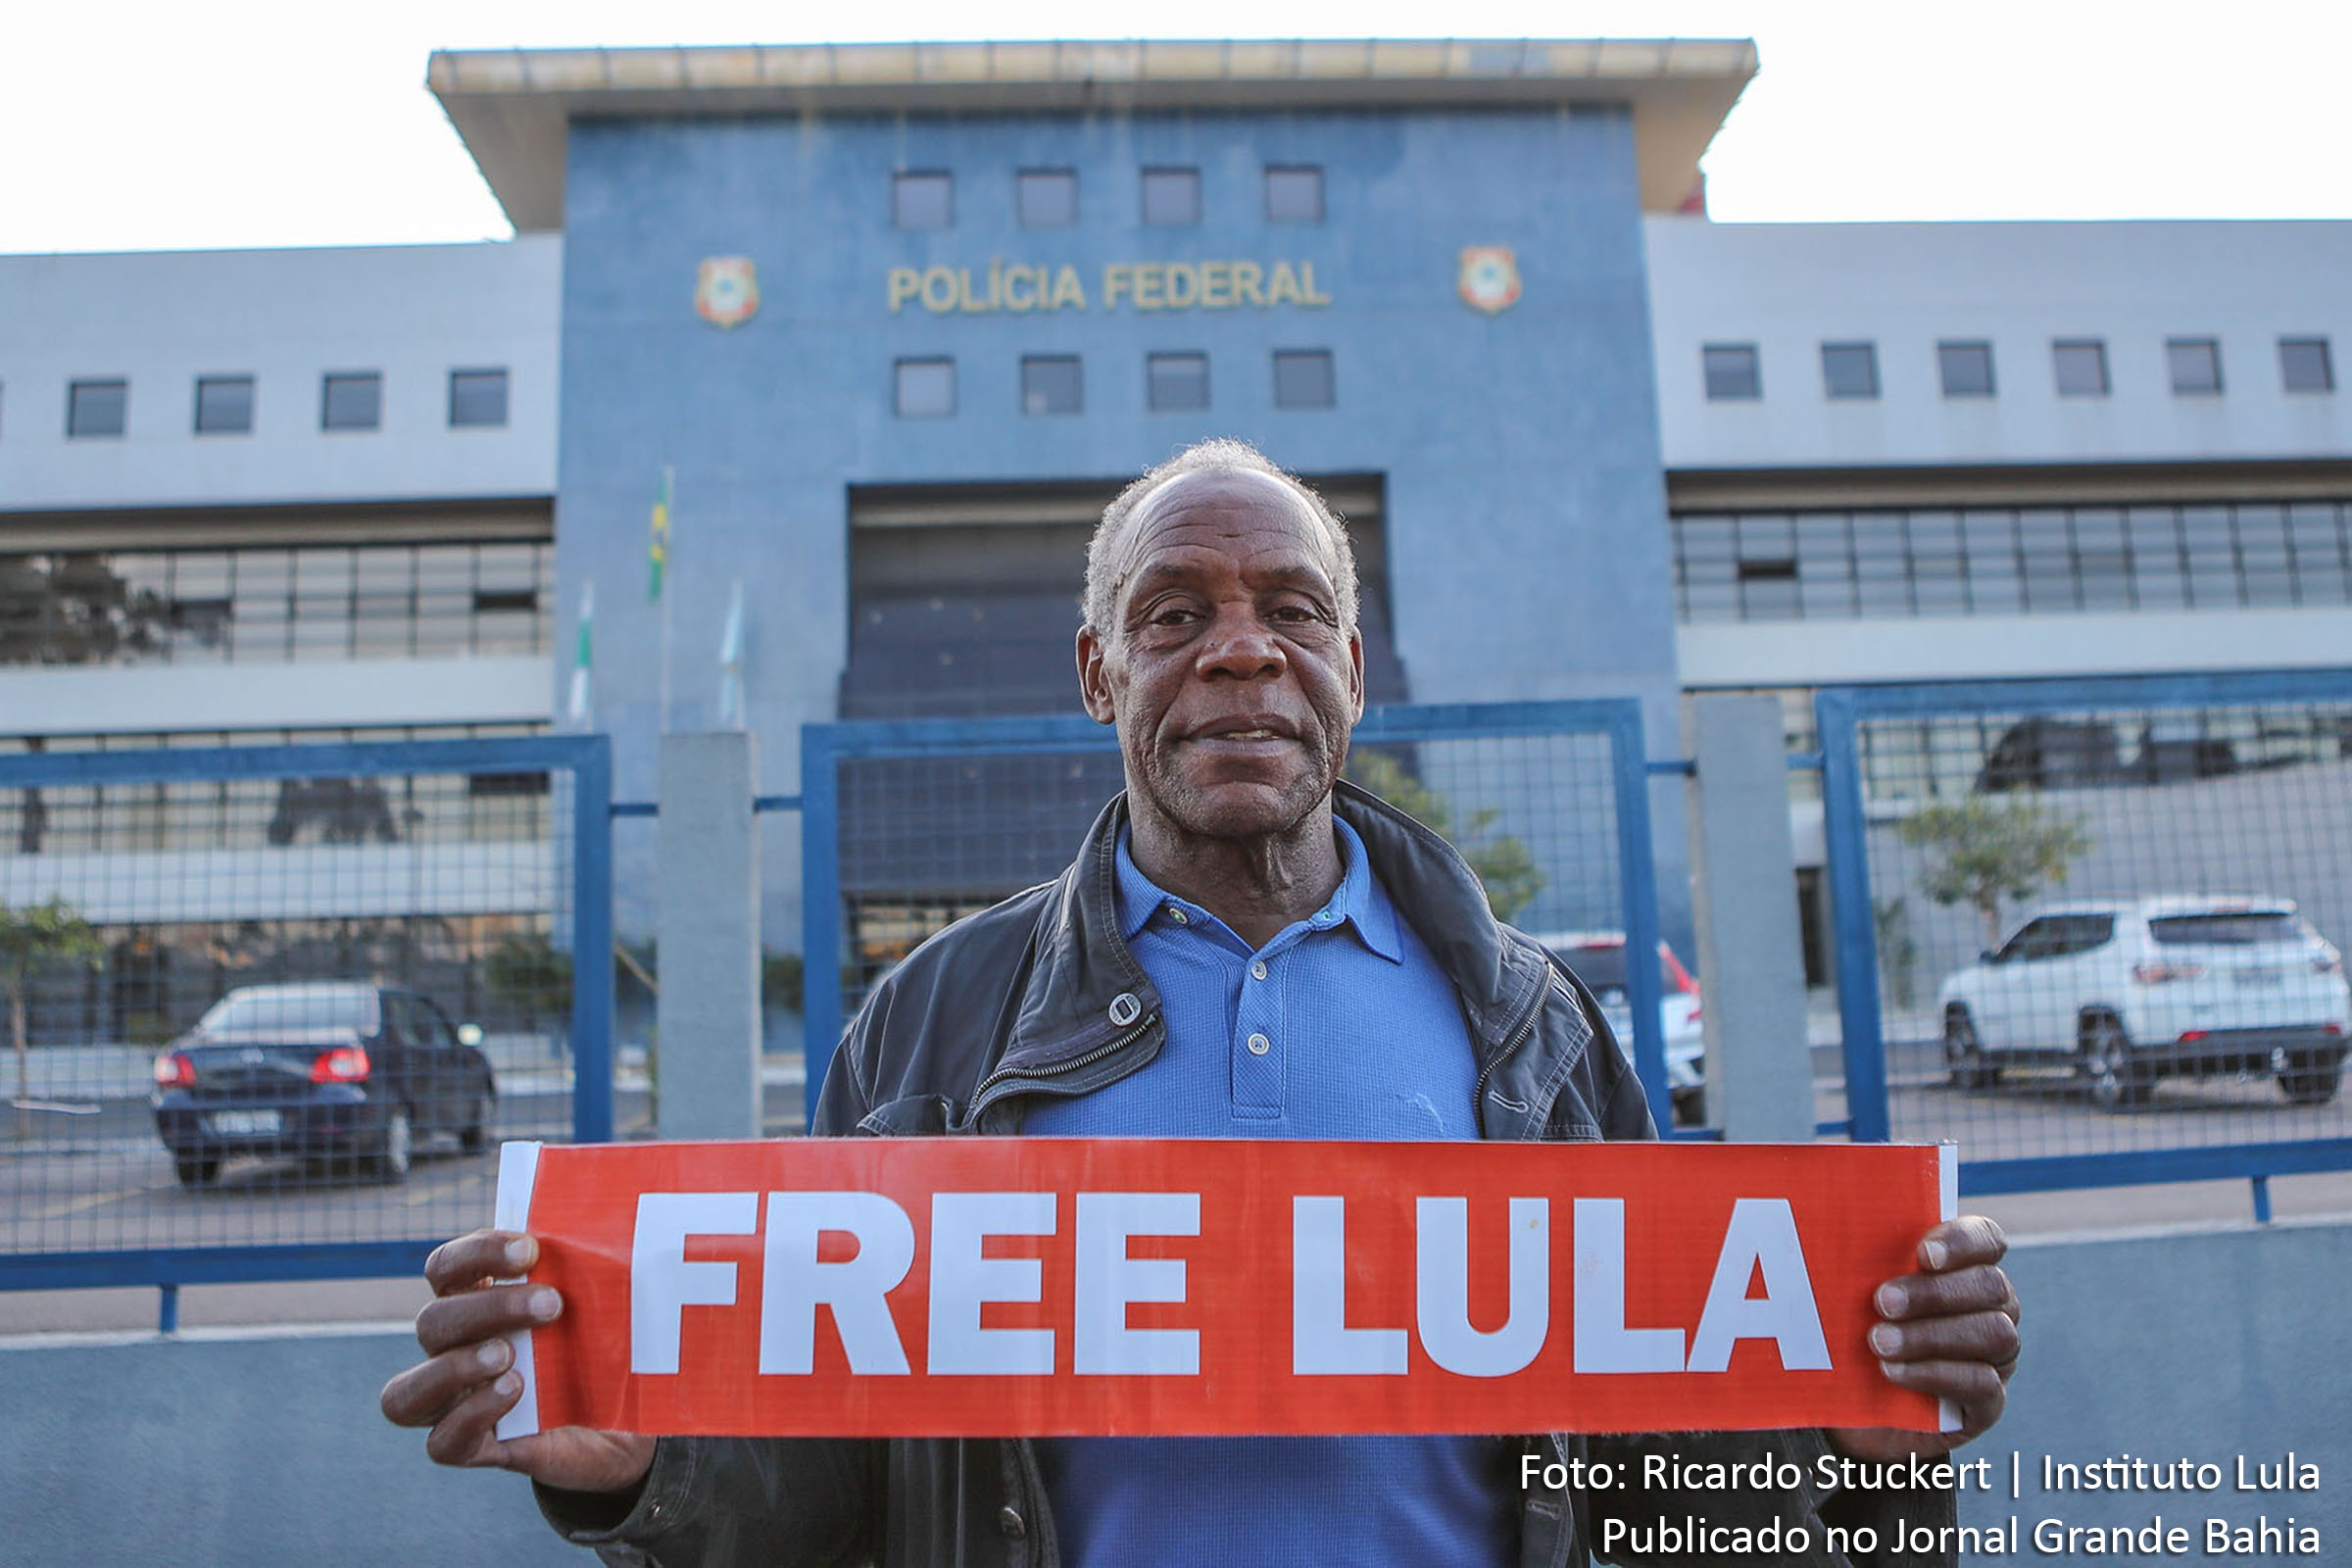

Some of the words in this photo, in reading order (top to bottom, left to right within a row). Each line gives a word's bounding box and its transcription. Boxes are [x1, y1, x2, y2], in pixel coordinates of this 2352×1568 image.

[889, 257, 1085, 313] POLÍCIA
[1103, 261, 1331, 310] FEDERAL
[630, 1191, 1201, 1376] FREE
[1292, 1195, 1833, 1377] LULA
